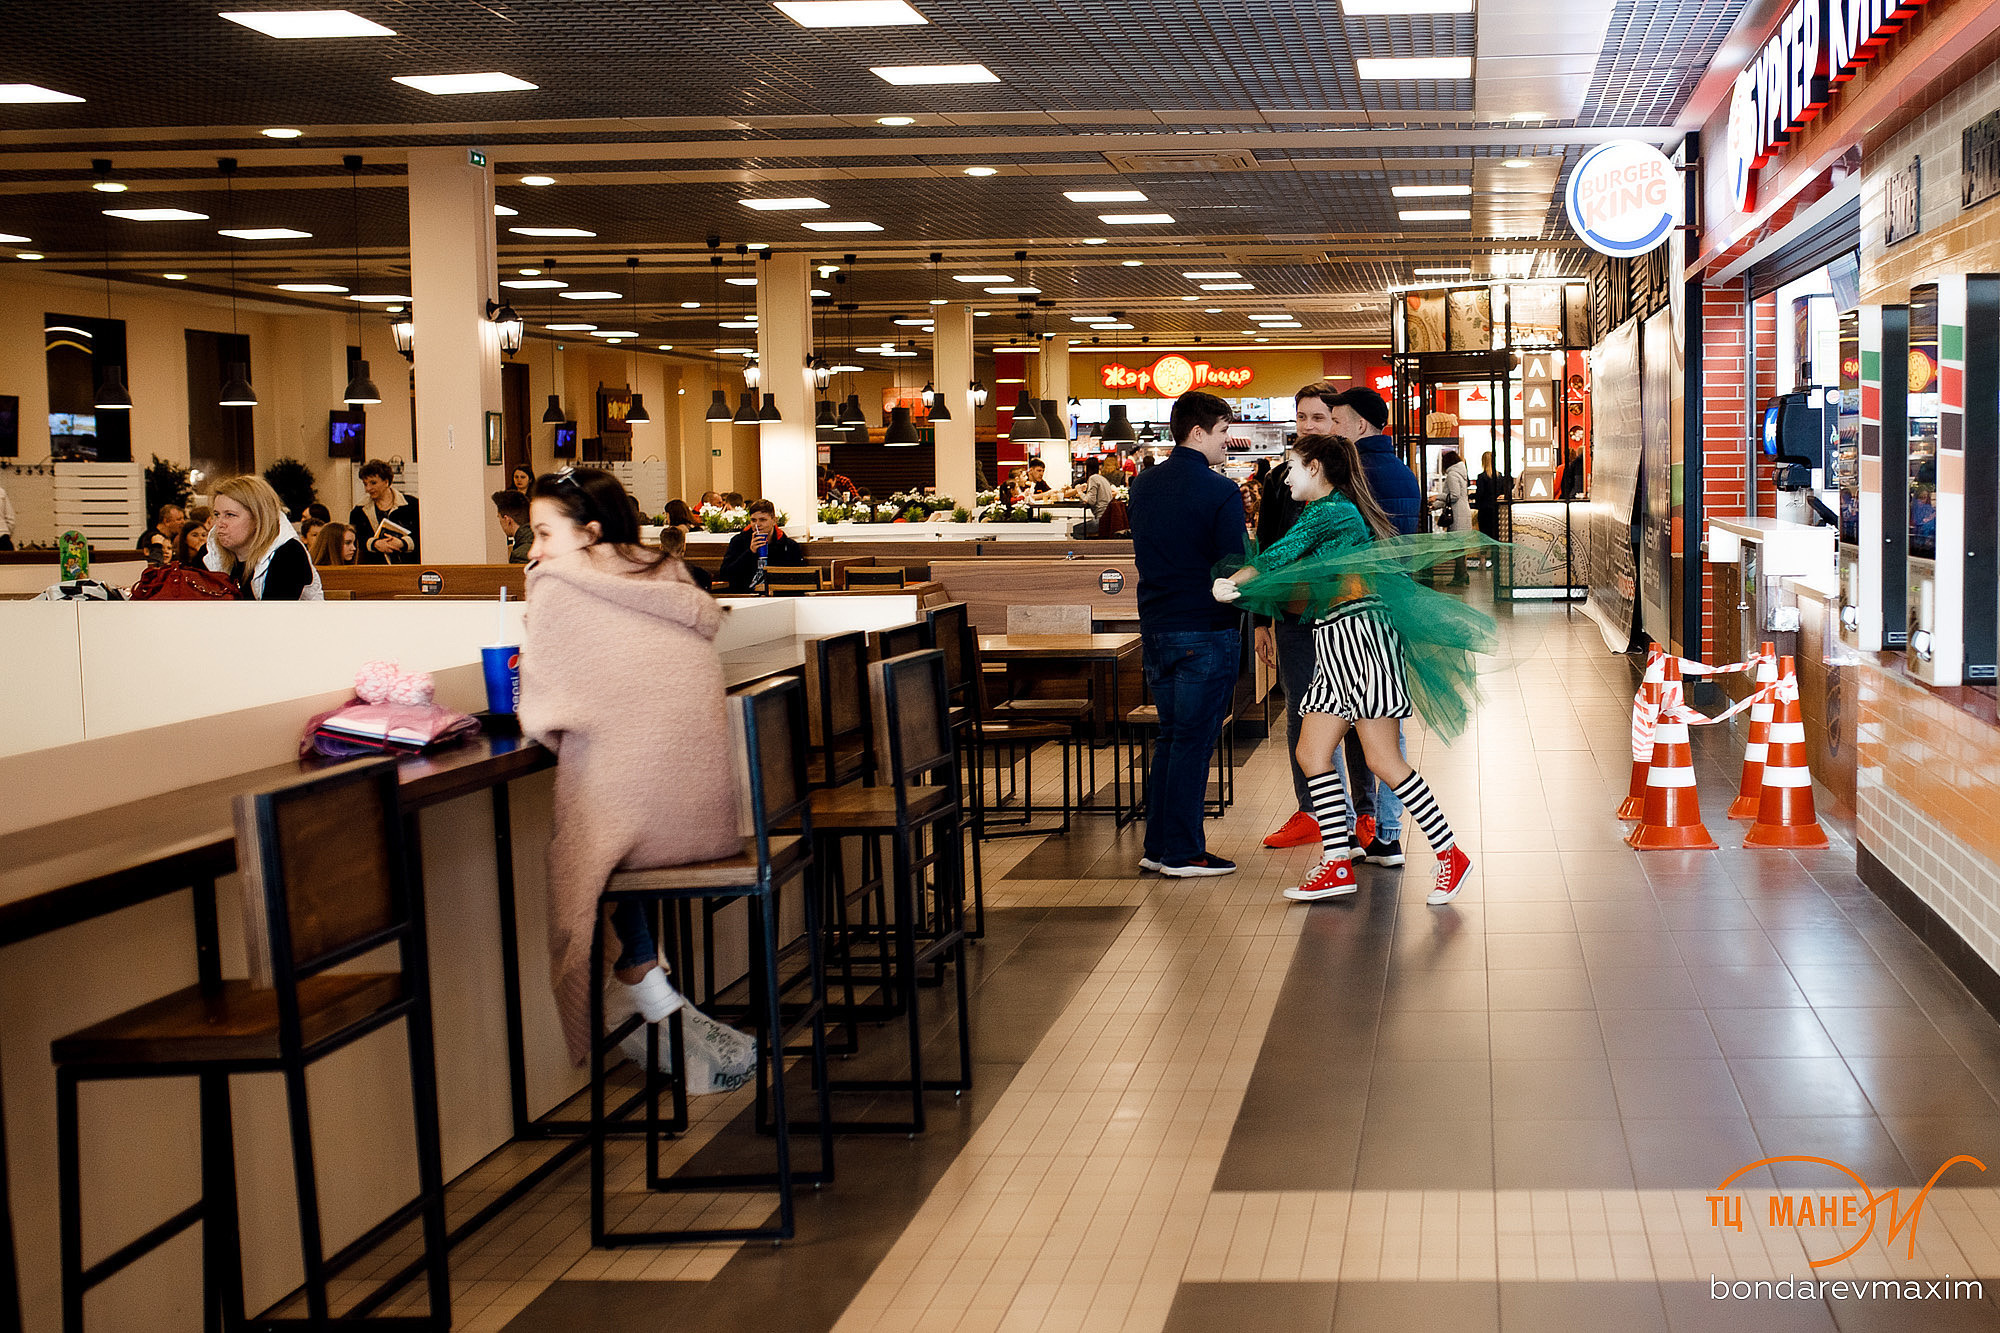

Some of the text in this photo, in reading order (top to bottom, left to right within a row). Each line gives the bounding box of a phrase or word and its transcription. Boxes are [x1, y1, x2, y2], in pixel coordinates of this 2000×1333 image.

[1581, 160, 1664, 200] BURGER
[1585, 179, 1667, 230] KING
[1104, 364, 1251, 391] Жар Пицца
[1526, 358, 1550, 497] ЛАПША
